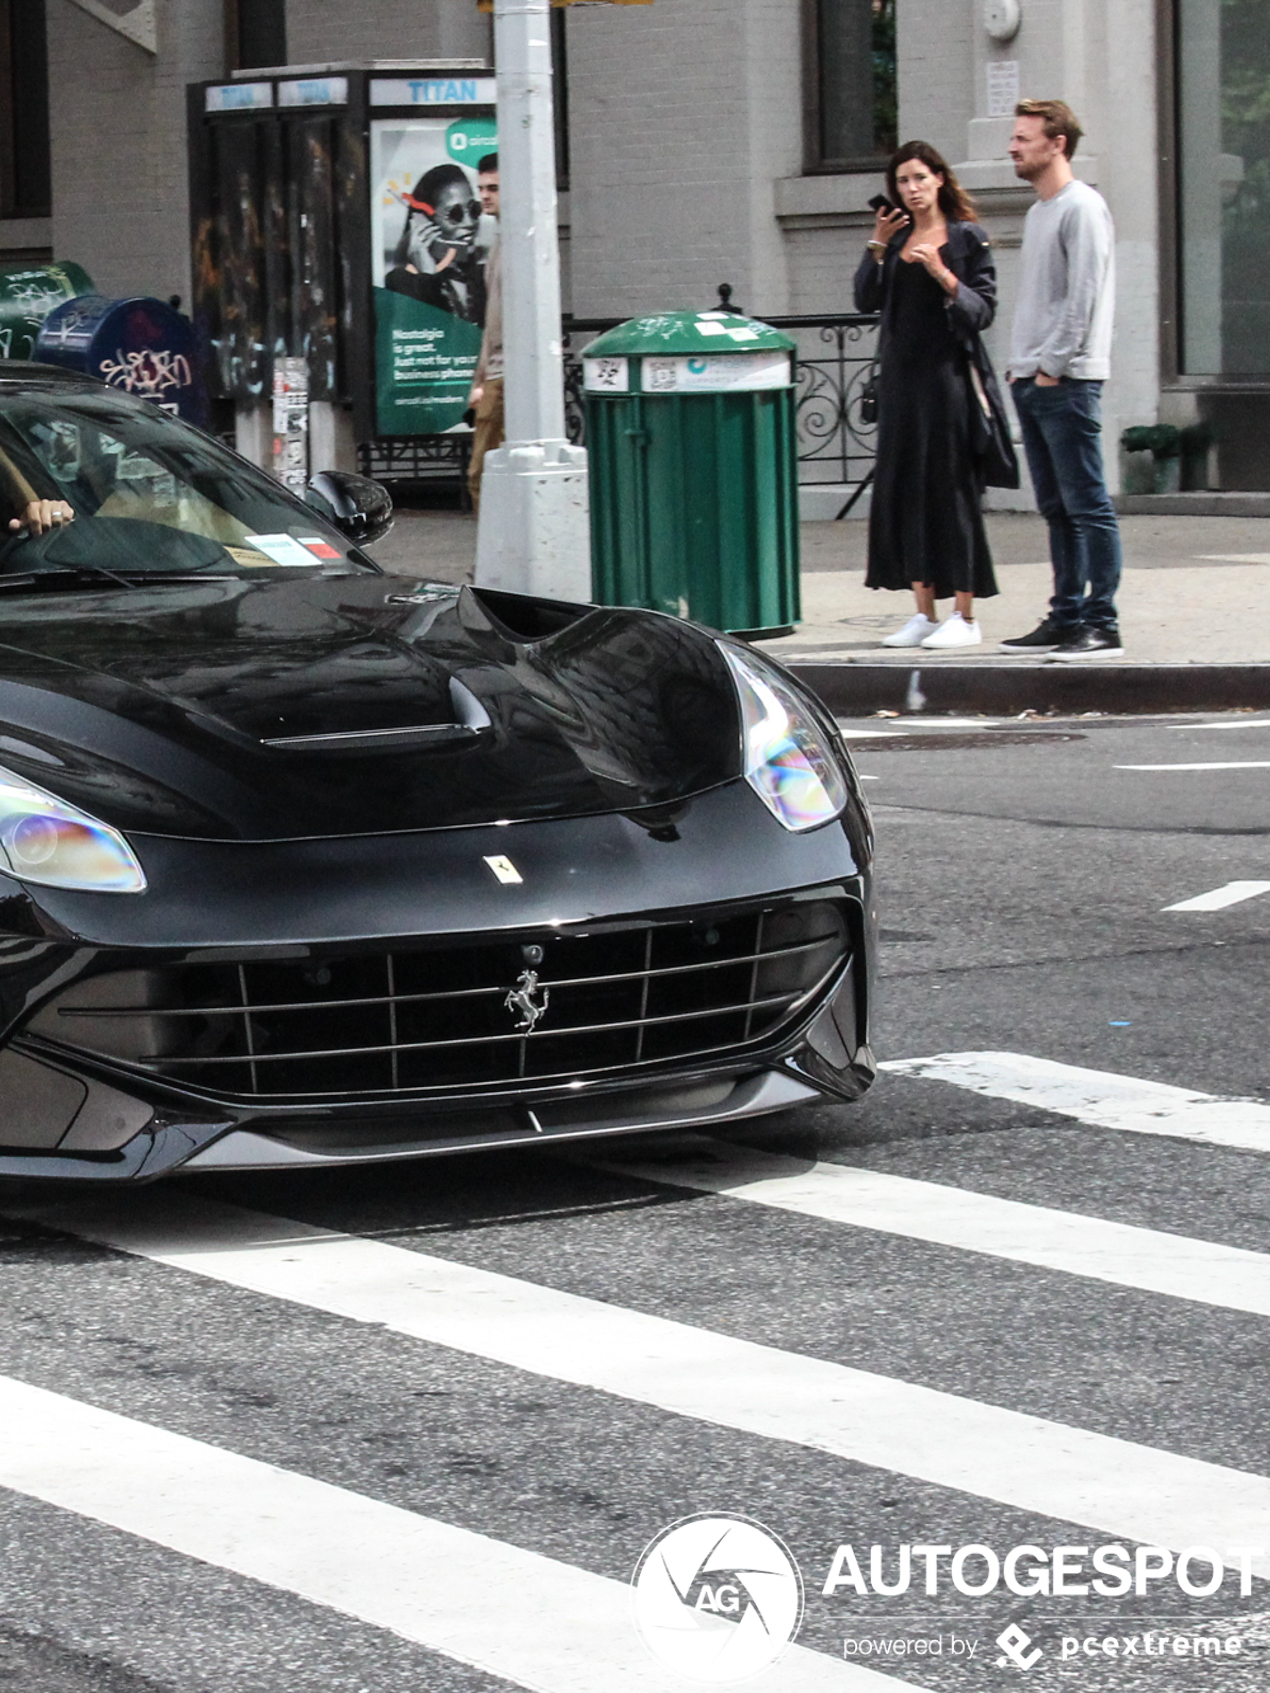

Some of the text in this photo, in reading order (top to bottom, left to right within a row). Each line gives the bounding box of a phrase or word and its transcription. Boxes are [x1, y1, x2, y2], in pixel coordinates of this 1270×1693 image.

[408, 80, 476, 102] TITAN
[392, 328, 445, 341] Nostalgia
[393, 343, 437, 355] is great.
[394, 354, 478, 367] Just not for your
[394, 369, 440, 381] business
